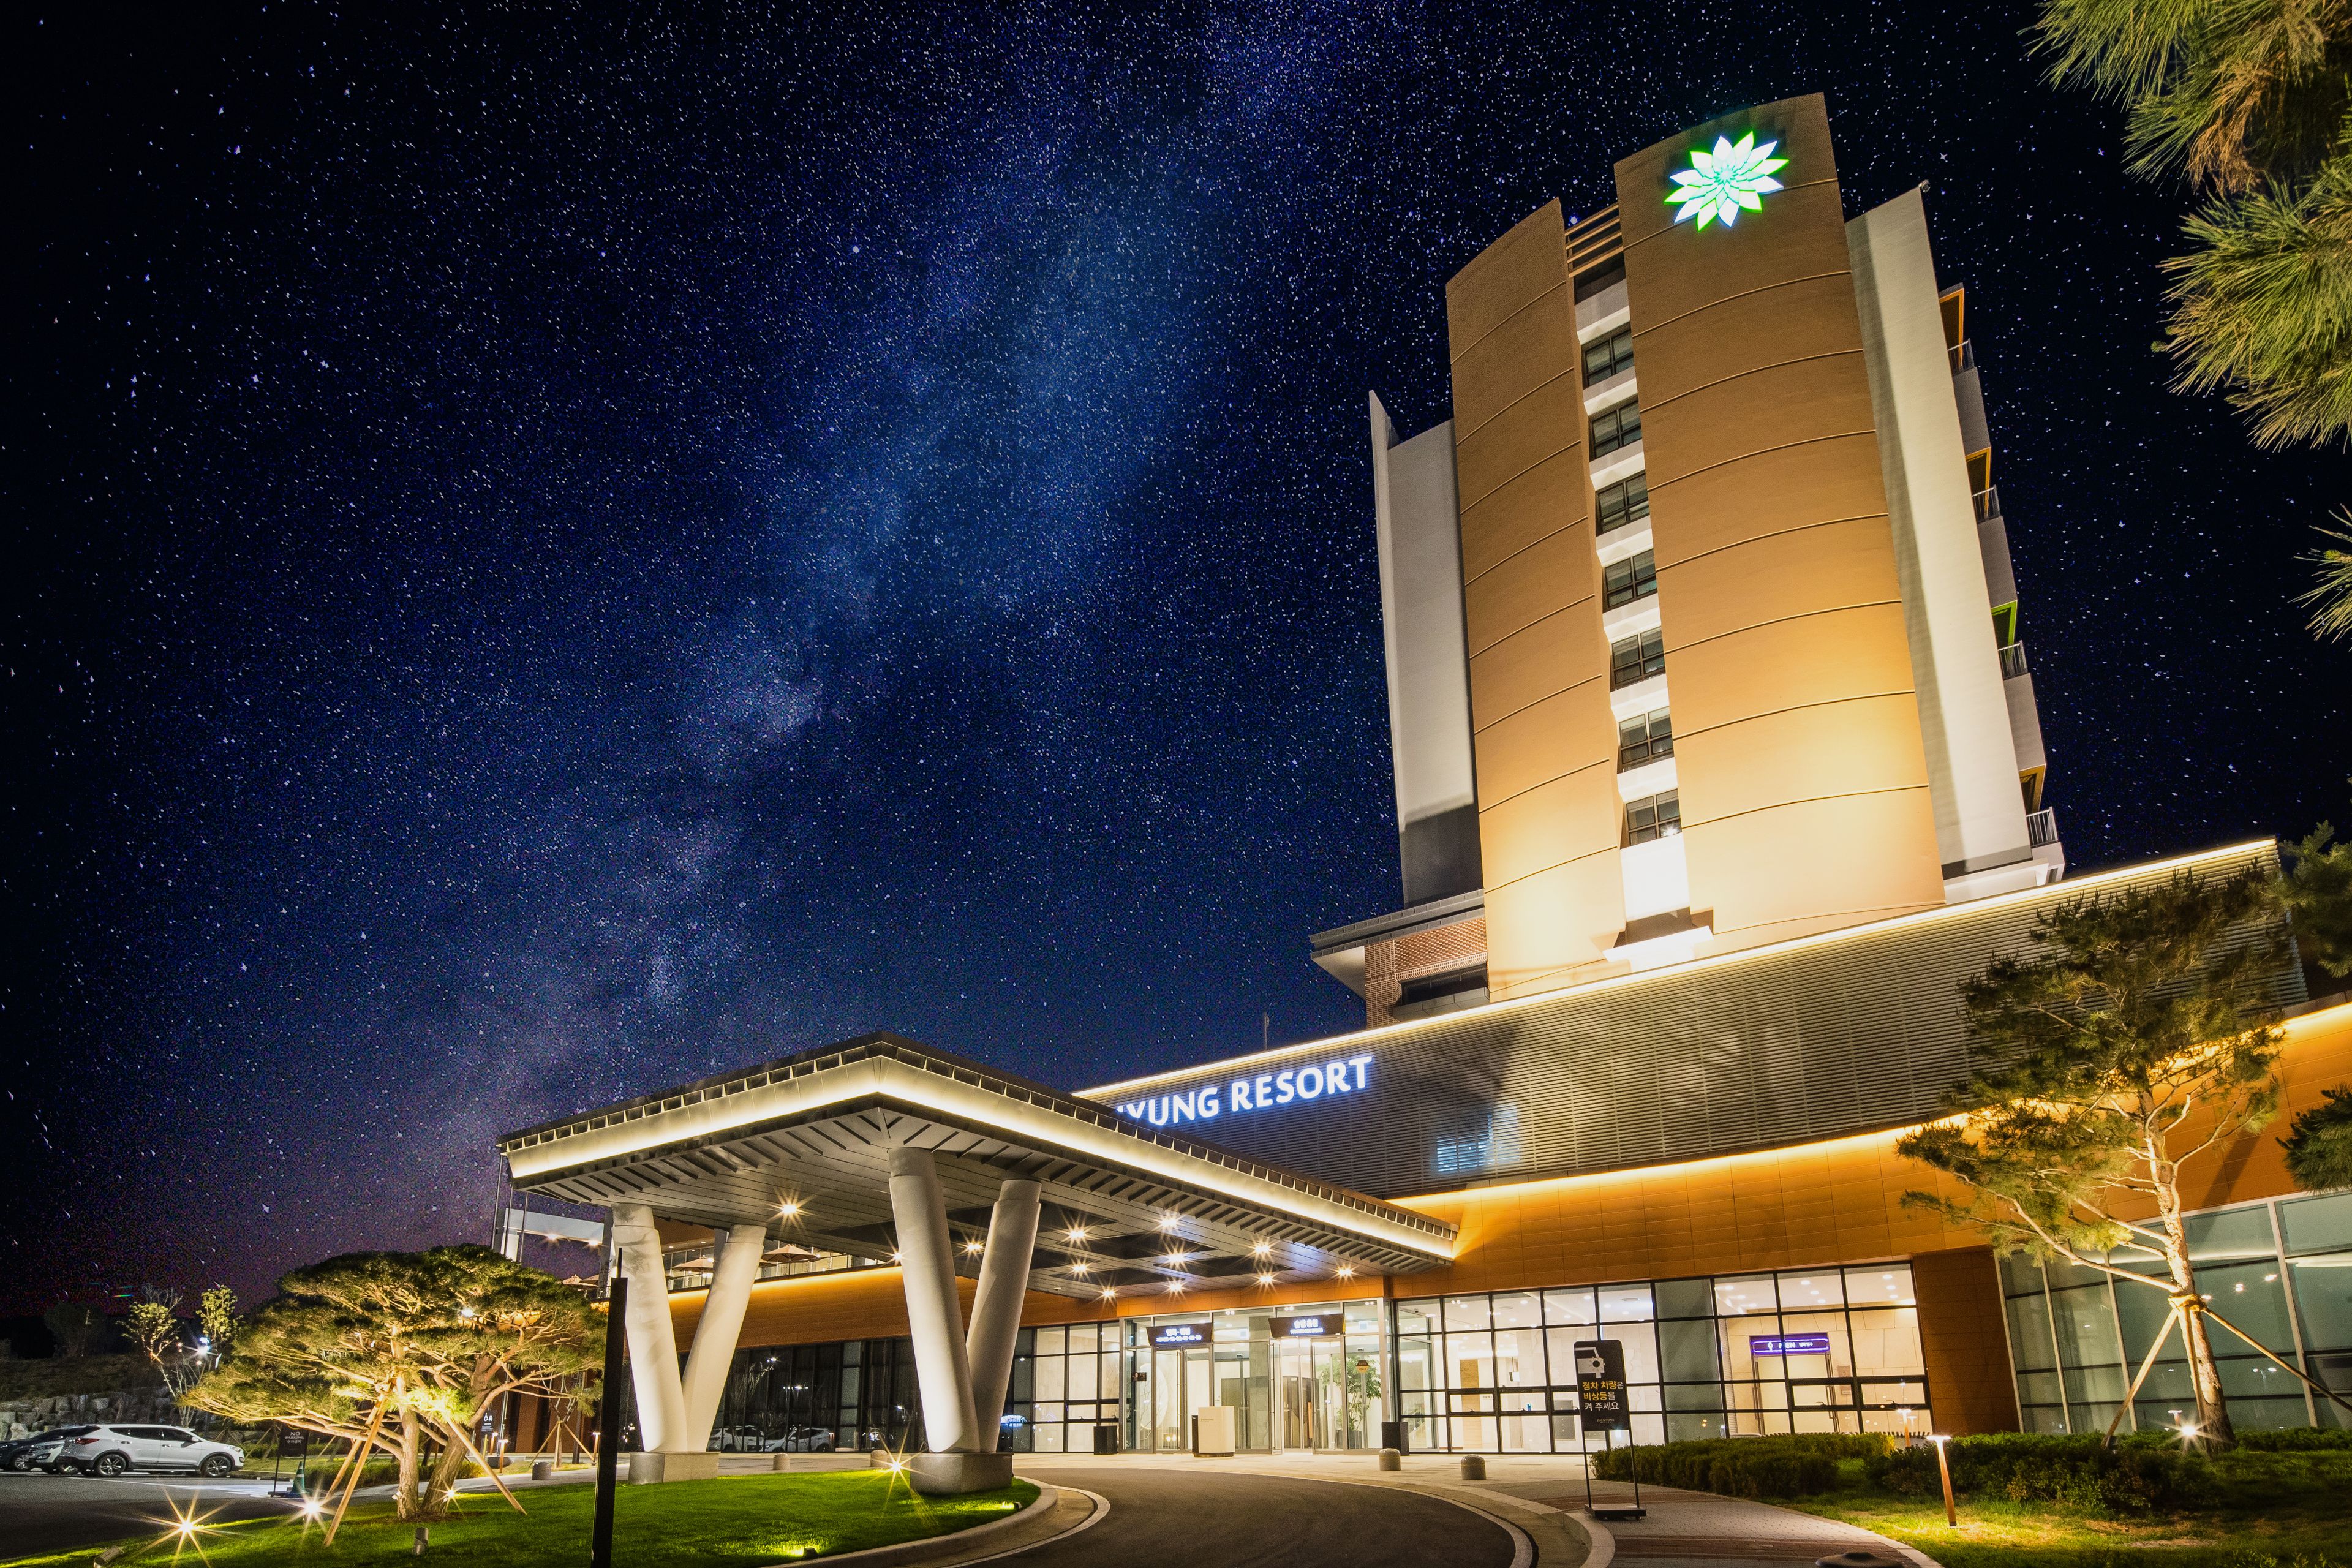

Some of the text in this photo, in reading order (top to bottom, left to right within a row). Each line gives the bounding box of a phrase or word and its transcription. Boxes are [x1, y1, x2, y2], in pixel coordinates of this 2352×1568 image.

[1117, 1055, 1373, 1126] YUNG RESORT
[1583, 1382, 1599, 1390] 정차
[1583, 1392, 1615, 1401] 비상등을
[1585, 1402, 1619, 1411] 켜 주세요
